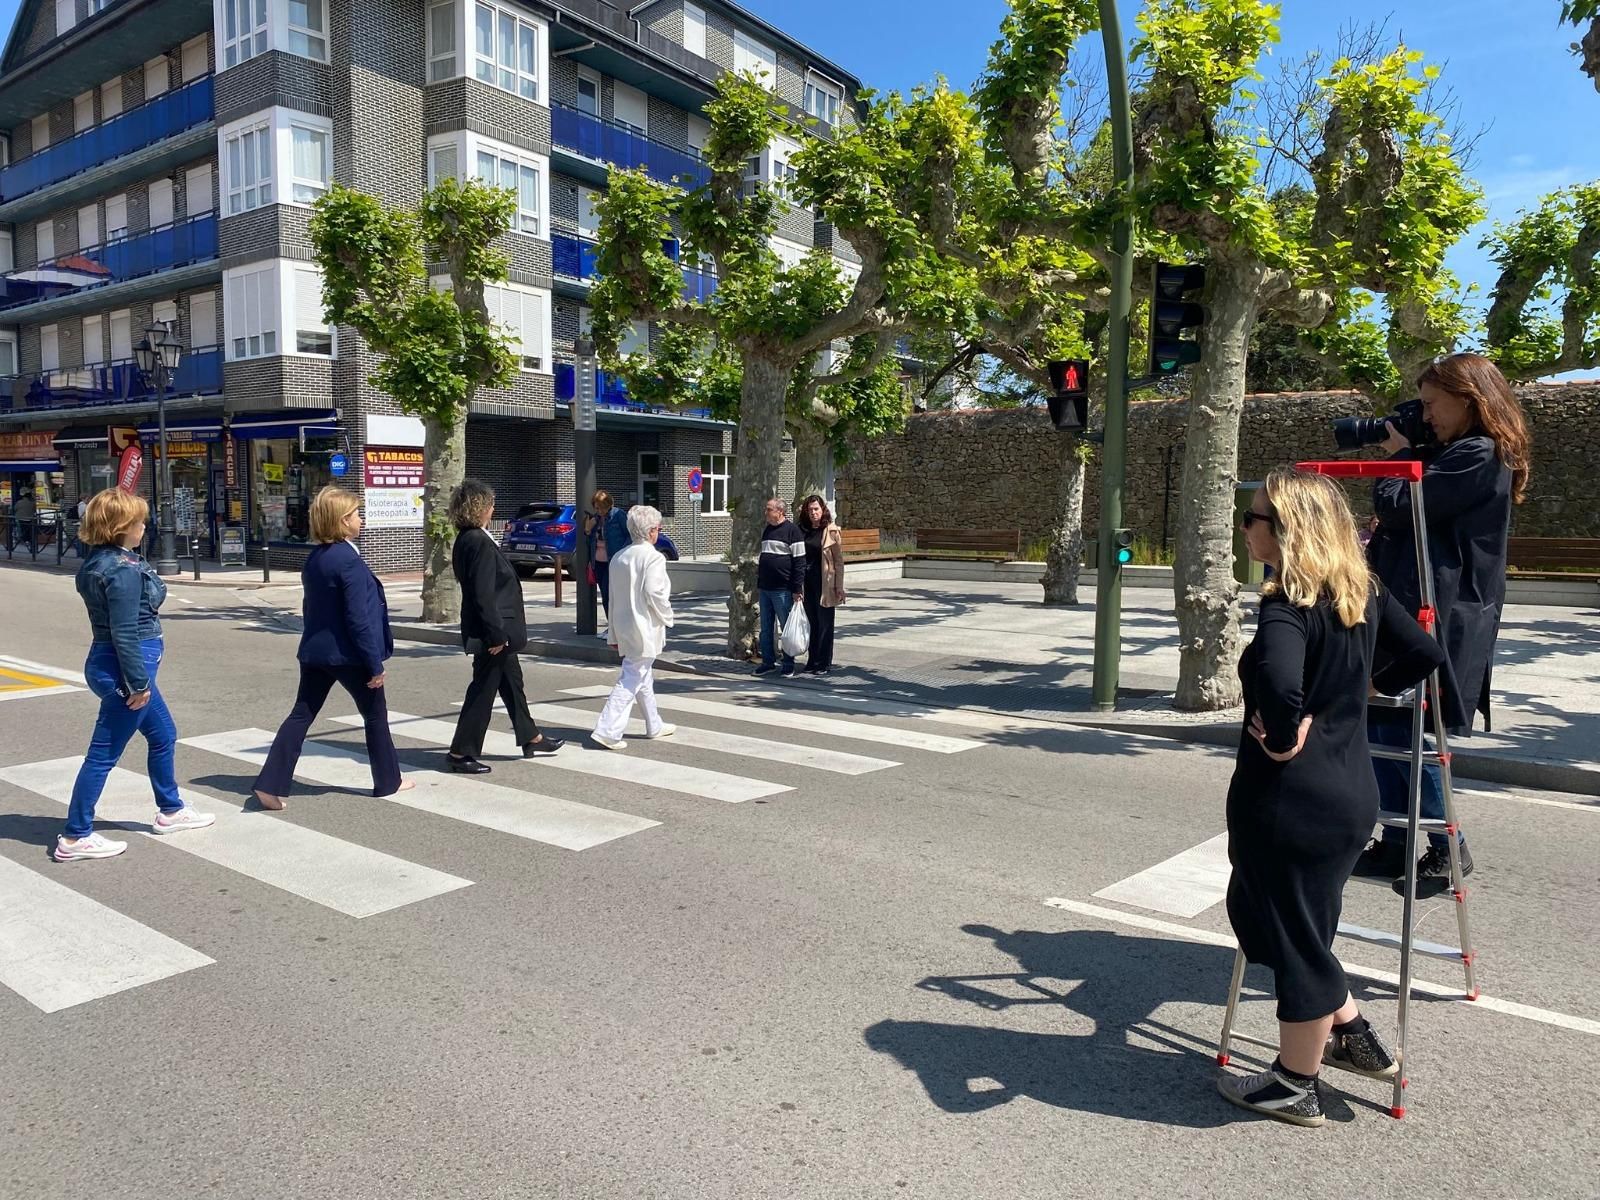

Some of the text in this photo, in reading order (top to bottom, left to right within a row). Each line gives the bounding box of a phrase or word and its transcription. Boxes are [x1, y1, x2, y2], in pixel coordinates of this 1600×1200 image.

[225, 433, 235, 485] TABACOS
[378, 451, 424, 462] TABACOS
[368, 499, 408, 508] fisioterapia
